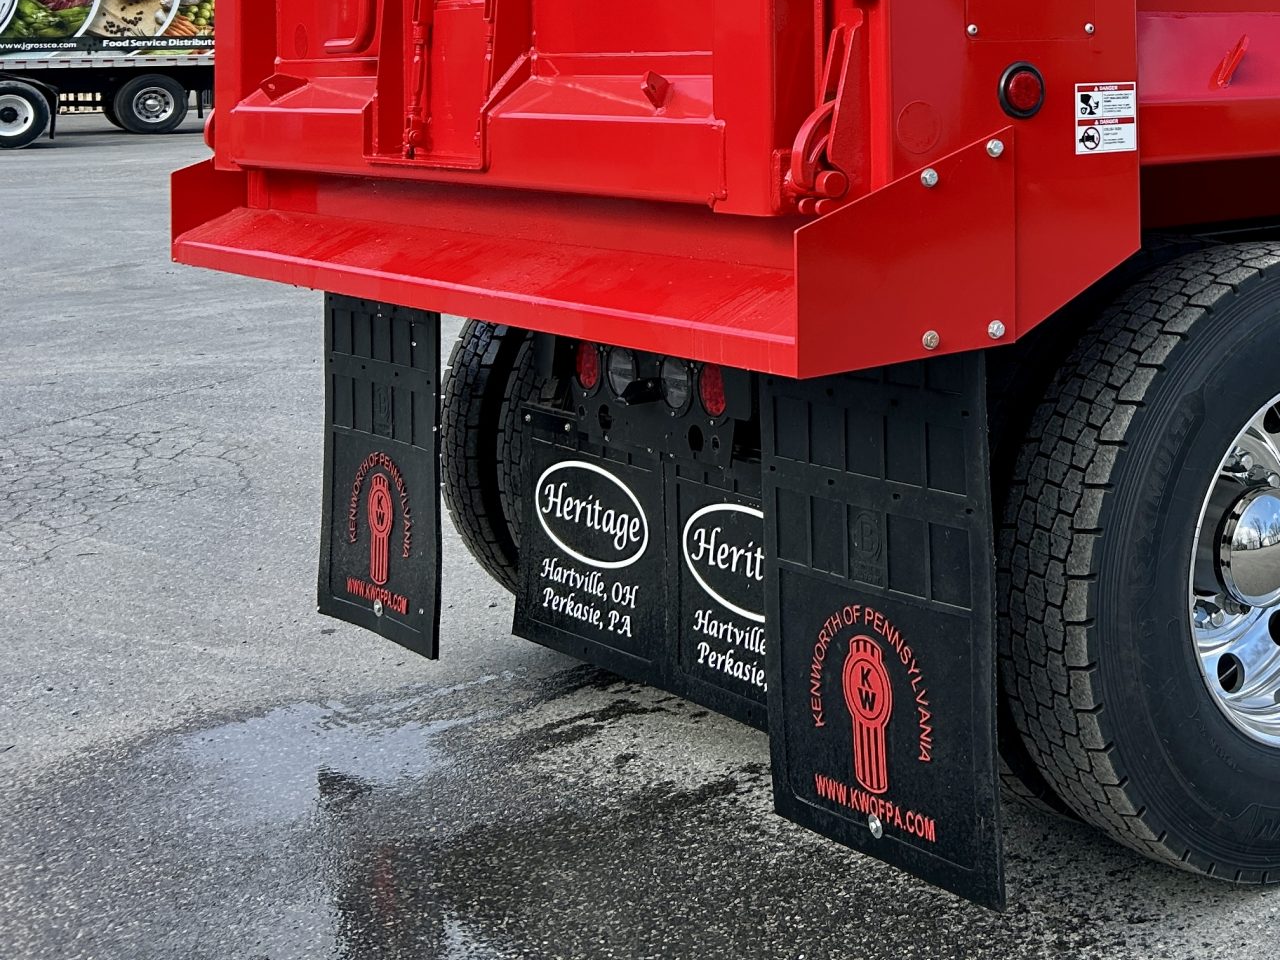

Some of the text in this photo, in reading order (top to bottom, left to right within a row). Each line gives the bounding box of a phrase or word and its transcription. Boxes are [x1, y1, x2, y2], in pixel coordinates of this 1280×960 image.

[131, 39, 167, 47] Service
[349, 451, 412, 559] KENWORTH OF PENNSYLVANIA
[542, 482, 641, 551] Heritage
[691, 527, 765, 581] Herit
[346, 577, 409, 615] WWW.KWOFPA.COM
[541, 558, 640, 609] Hartville, OH
[543, 587, 633, 638] Perkasie, PA
[693, 609, 767, 656] Hartville
[810, 604, 934, 763] KENWORTH OF PENNSYLVANIA
[814, 773, 936, 843] WWW.KWOFPA.COM
